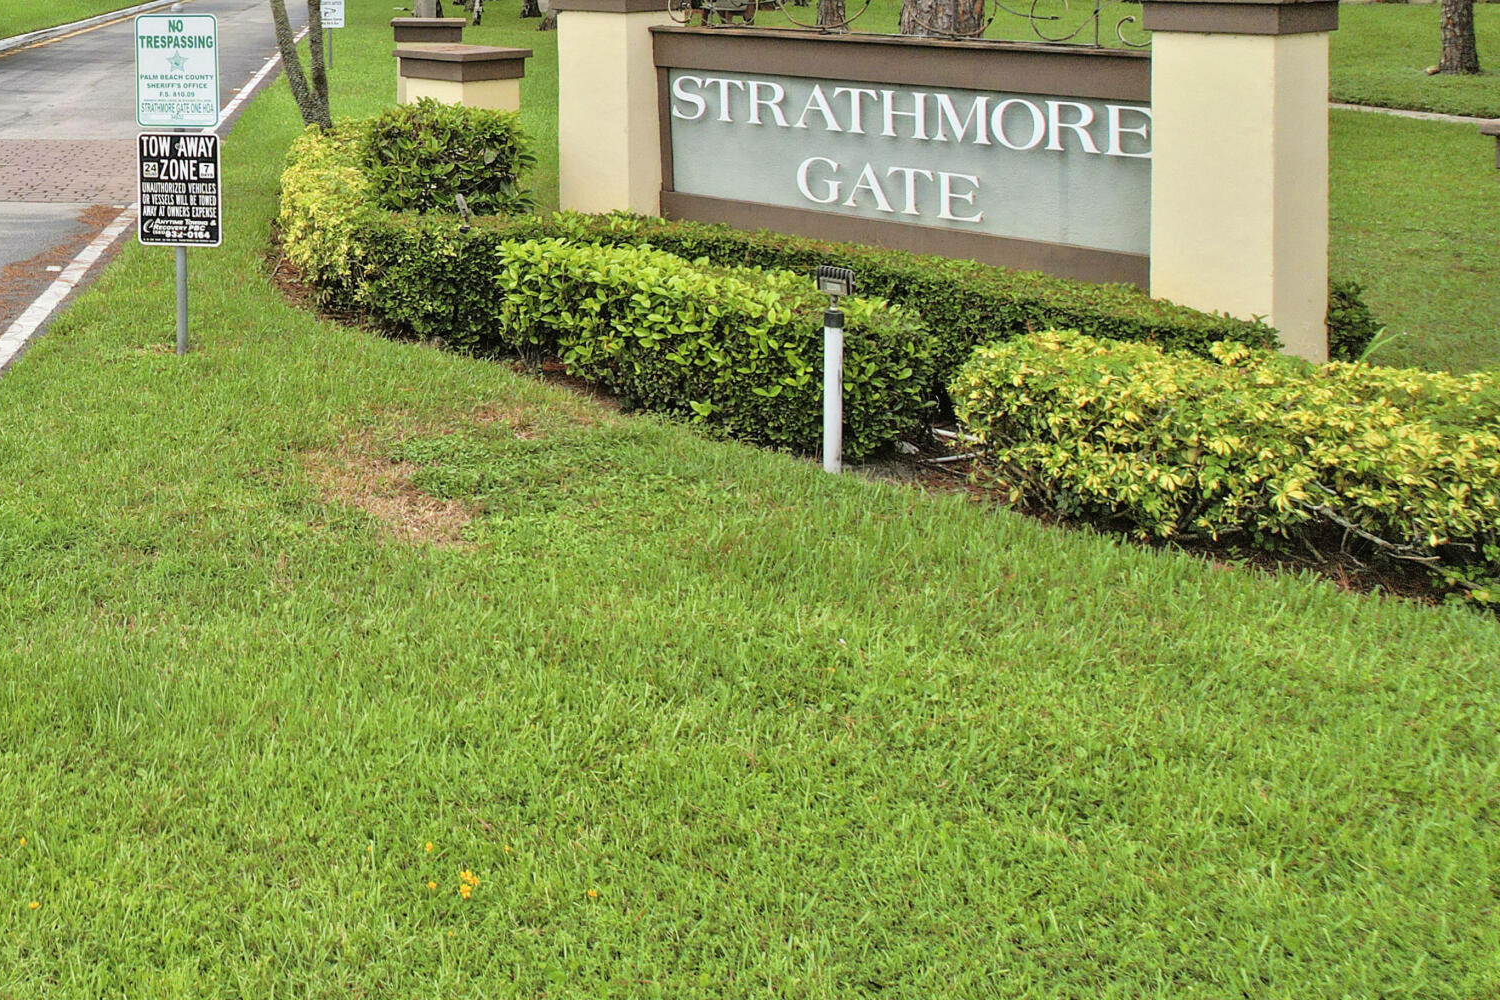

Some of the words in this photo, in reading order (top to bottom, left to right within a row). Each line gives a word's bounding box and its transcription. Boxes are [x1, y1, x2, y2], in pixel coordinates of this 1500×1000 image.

[168, 19, 184, 33] NO
[139, 35, 214, 49] TRESPASSING
[141, 102, 175, 113] STRATHMORE
[176, 102, 190, 113] GATE
[672, 75, 1151, 159] STRATHMORE
[141, 136, 171, 157] TOW
[177, 136, 215, 158] AWAY
[144, 163, 157, 172] 24
[159, 159, 198, 180] ZONE
[203, 164, 210, 173] 7
[141, 181, 186, 194] UNAUTHORIZED
[188, 182, 217, 194] VEHICLES
[797, 156, 985, 223] GATE
[142, 194, 150, 204] OR
[151, 194, 175, 205] VESSELS
[175, 194, 189, 206] WILL
[189, 195, 197, 206] BE
[198, 195, 217, 206] TOWED
[143, 205, 157, 217] AWAY
[158, 205, 166, 217] AT
[167, 206, 190, 217] OWNERS
[191, 207, 217, 218] EXPENSE
